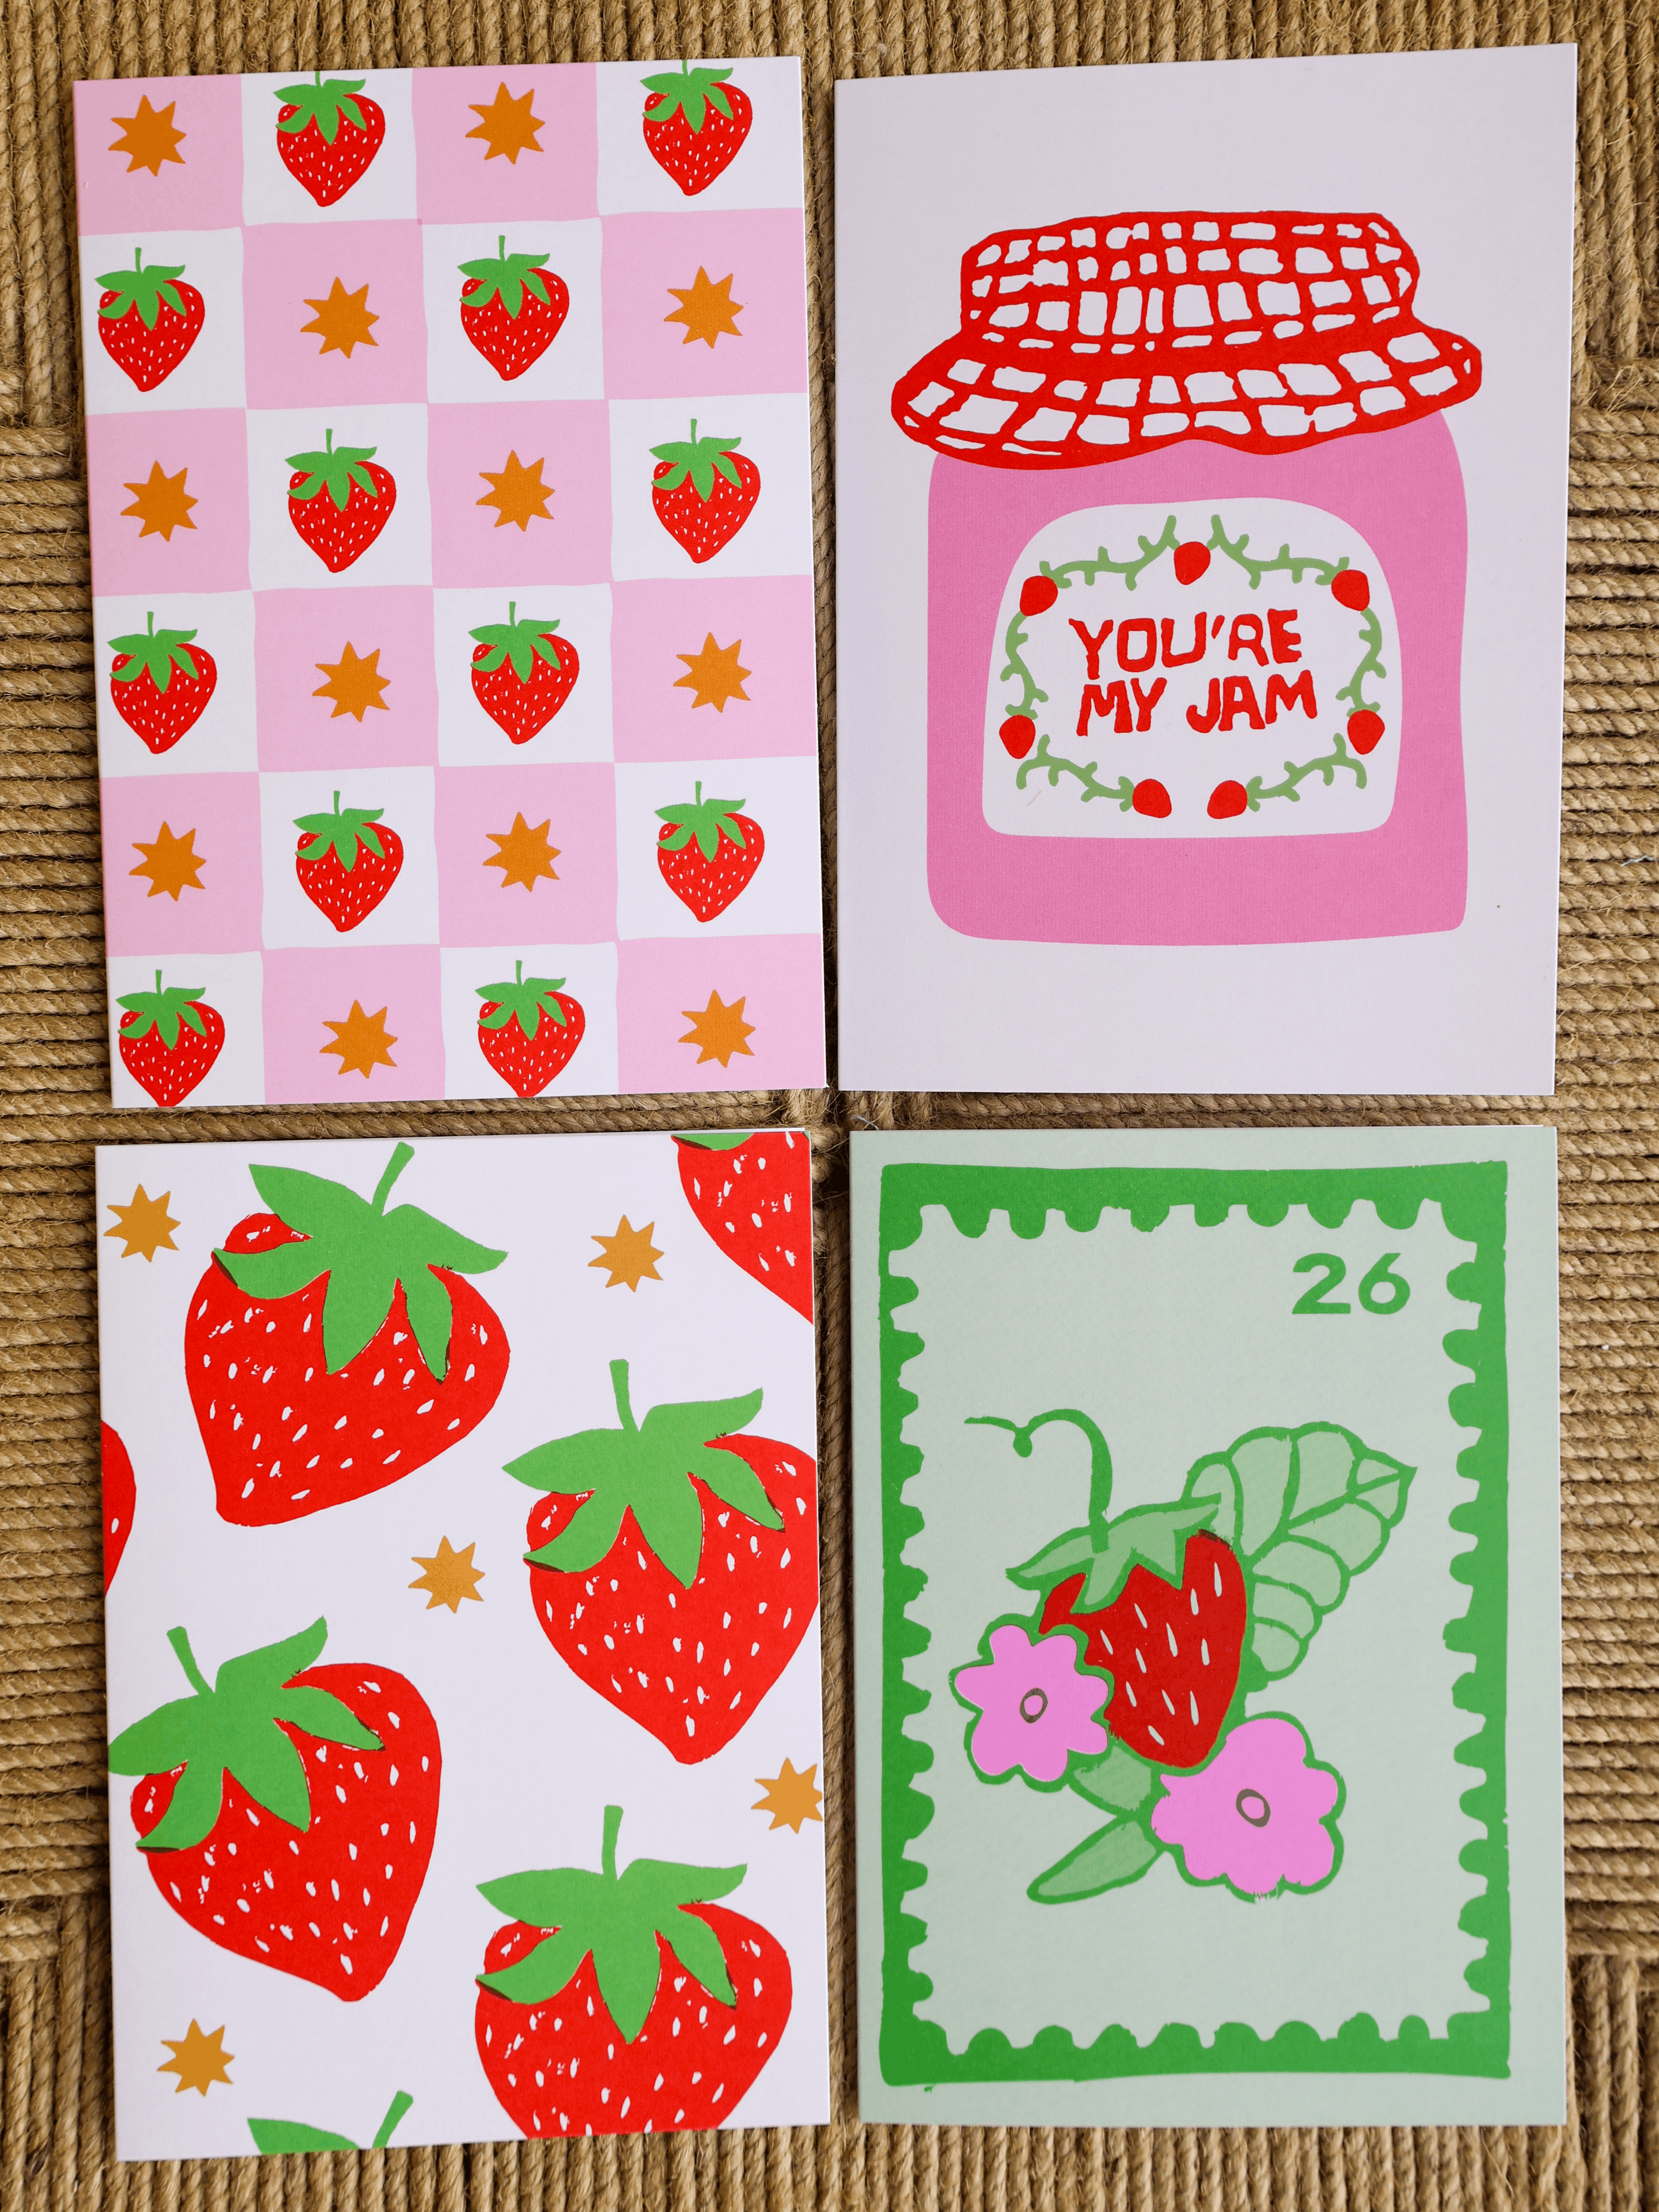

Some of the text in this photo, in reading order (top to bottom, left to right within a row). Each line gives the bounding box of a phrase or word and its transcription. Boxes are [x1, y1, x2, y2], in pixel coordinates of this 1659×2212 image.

[1068, 609, 1302, 680] YOU'RE
[1076, 670, 1318, 736] MY JAM
[1292, 1252, 1411, 1314] 26
